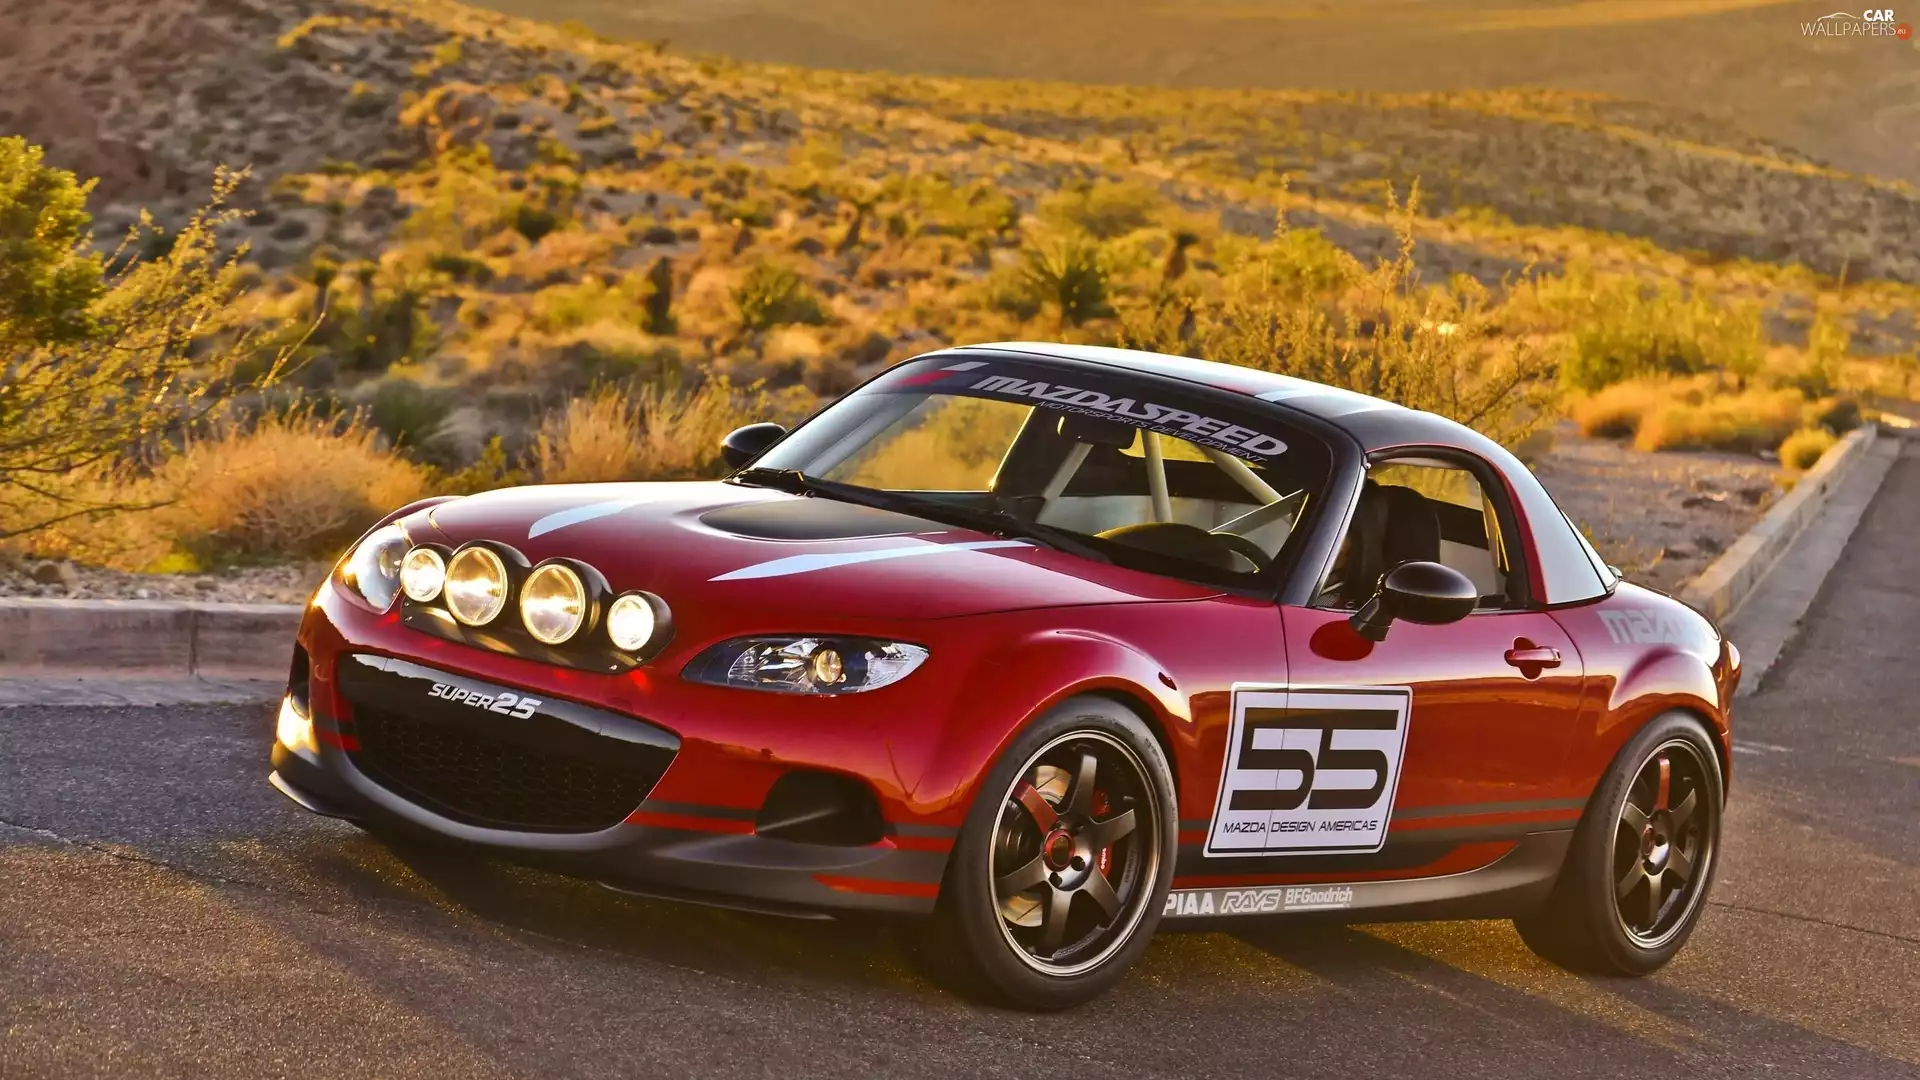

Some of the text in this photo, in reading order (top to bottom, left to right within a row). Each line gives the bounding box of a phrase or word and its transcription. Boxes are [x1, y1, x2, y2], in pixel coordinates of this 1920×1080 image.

[970, 375, 1288, 456] MAZDASPEED
[1149, 425, 1268, 461] DEVELOPMENT
[1229, 707, 1399, 811] 55
[1223, 820, 1378, 833] MAZDA DESIGN AMERICAS
[1162, 886, 1353, 916] PIAA RAYS BFGoodrich
